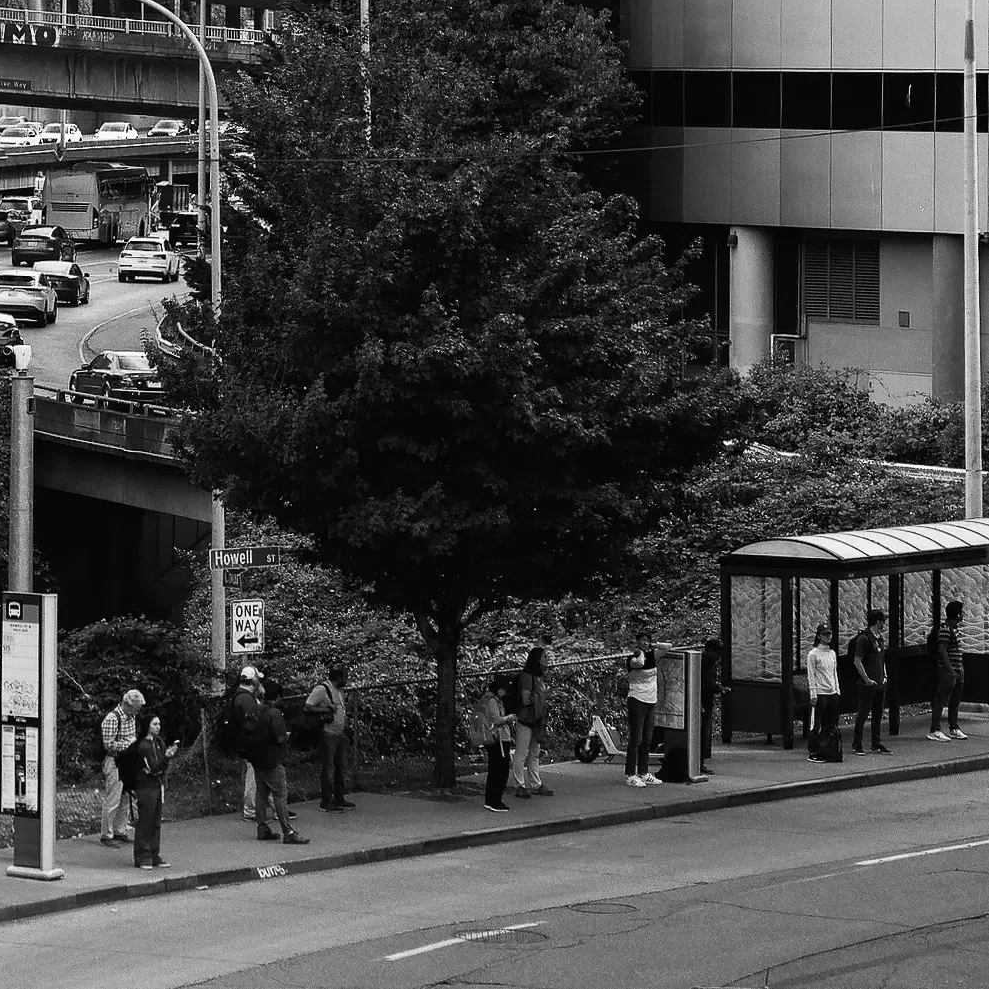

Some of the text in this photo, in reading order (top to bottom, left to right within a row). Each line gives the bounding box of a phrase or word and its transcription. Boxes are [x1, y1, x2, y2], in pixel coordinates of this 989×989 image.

[13, 81, 27, 89] Way
[215, 549, 276, 566] Howell ST
[235, 605, 259, 617] ONE
[235, 619, 260, 632] WAY
